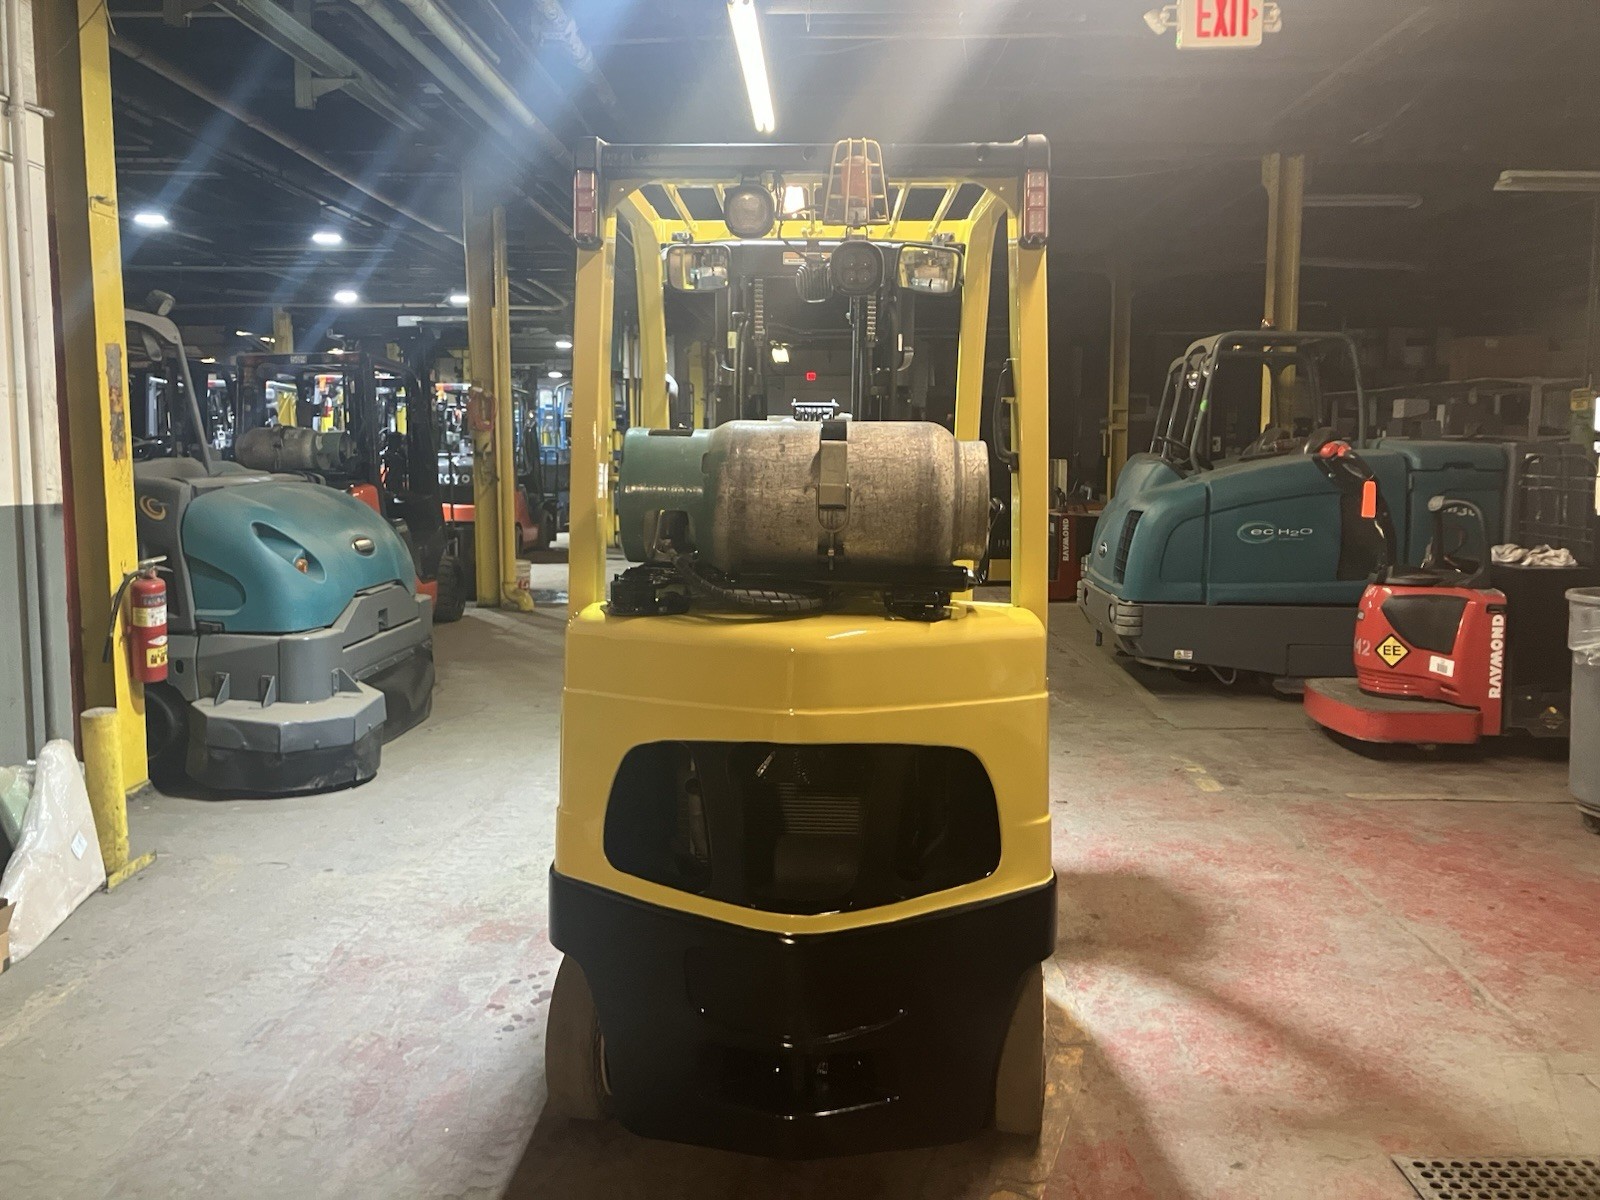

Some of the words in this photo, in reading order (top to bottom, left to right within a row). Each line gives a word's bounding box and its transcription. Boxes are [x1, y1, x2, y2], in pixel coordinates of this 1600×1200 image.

[1062, 518, 1070, 562] RAYMOND
[1383, 645, 1402, 656] EE
[1488, 614, 1504, 699] RAYMOND
